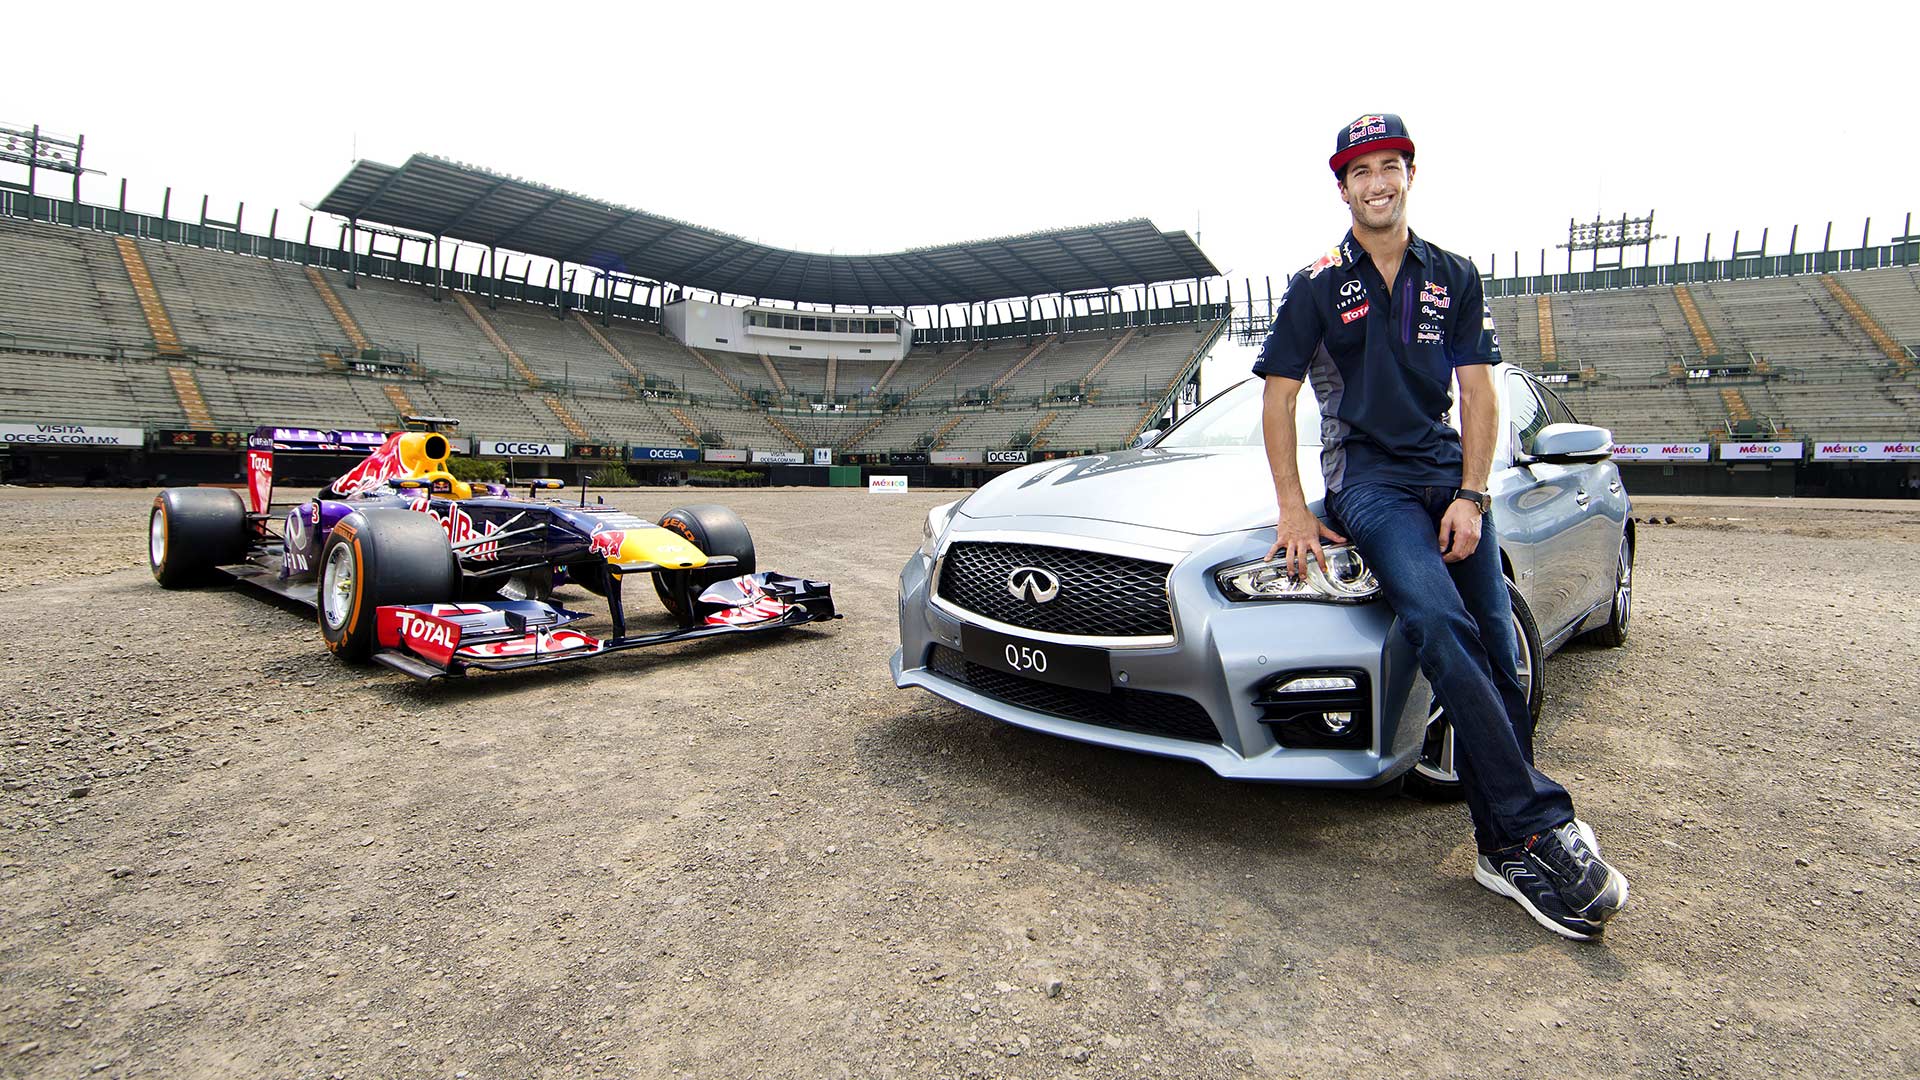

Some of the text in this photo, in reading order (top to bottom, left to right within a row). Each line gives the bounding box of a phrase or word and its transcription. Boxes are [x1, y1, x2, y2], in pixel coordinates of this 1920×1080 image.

[1349, 127, 1367, 142] Red
[1367, 124, 1386, 136] Bull
[36, 425, 85, 434] VISITA
[4, 433, 119, 445] OCESA.COM.MX
[494, 442, 551, 456] OCESA
[649, 449, 684, 459] OCESA
[989, 451, 1026, 462] OCESA
[250, 453, 273, 472] TOTAL
[311, 501, 321, 524] 3
[662, 517, 696, 541] ZERO
[396, 611, 455, 649] TOTAL
[1005, 643, 1048, 673] Q50
